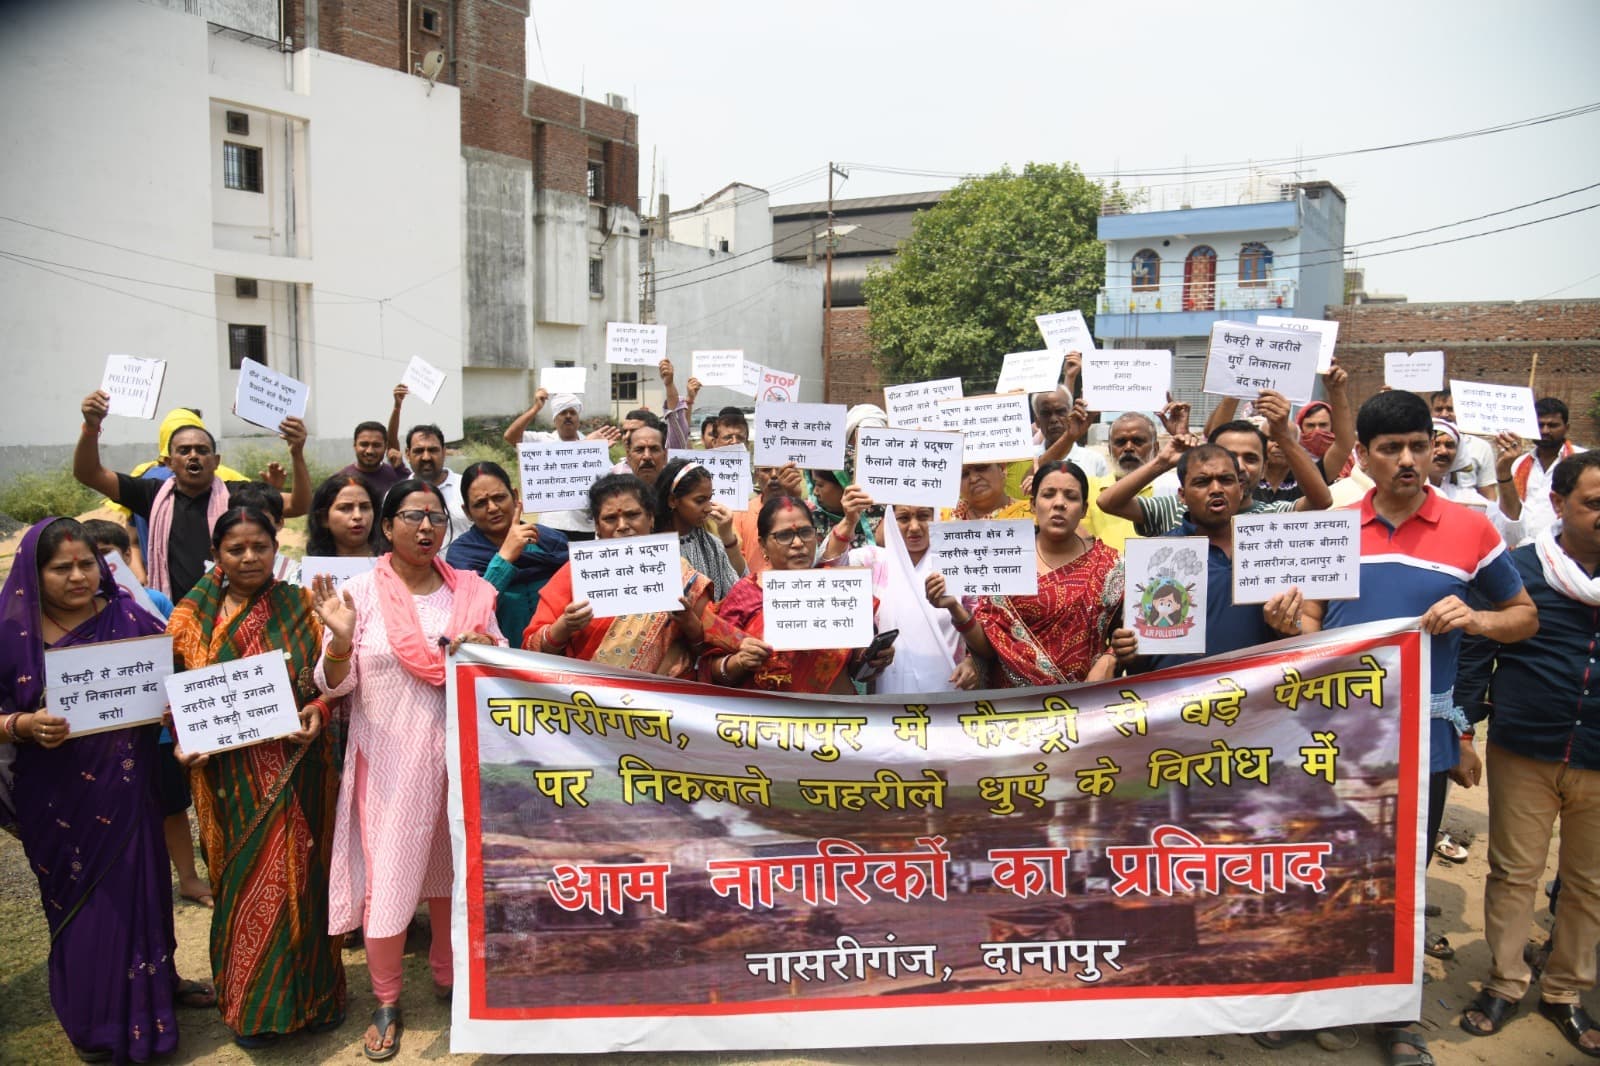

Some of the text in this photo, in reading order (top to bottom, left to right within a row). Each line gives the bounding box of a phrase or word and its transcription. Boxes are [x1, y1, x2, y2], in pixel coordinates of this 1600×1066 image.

[1224, 333, 1302, 352] फैक्ट्री से जहरीले
[1249, 356, 1291, 371] निकालना
[764, 374, 795, 386] STOP
[1236, 374, 1249, 386] बंद
[765, 419, 831, 431] फैक्ट्री से जहरीले
[780, 436, 816, 447] निकालना
[821, 437, 832, 448] बंद
[861, 436, 954, 454] ग्रीन जोन में प्रदूषण
[720, 459, 743, 468] प्रदूषण
[865, 455, 947, 471] फैलाने वाले फैक्ट्री
[719, 472, 738, 482] फैक्ट्री
[868, 475, 916, 487] चलाना बंद
[944, 528, 1015, 540] आवासीय क्षेत्र में
[1237, 524, 1264, 536] प्रदूषण
[1269, 522, 1278, 531] के
[1283, 522, 1308, 531] कारण
[1265, 539, 1283, 550] जैसी
[1289, 540, 1314, 548] घातक
[1320, 536, 1348, 547] बीमारी
[574, 544, 669, 561] ग्रीन जोन में प्रदूषण
[939, 548, 969, 559] जहरीले
[993, 546, 1022, 556] उगलने
[1242, 559, 1249, 569] से
[1337, 554, 1346, 563] के
[581, 561, 666, 580] फैलाने वाले फैक्ट्री
[942, 564, 1022, 576] वाले फैक्ट्री चलाना
[767, 578, 862, 592] ग्रीन जोन में प्रदूषण
[1240, 576, 1259, 586] लोगों
[1281, 574, 1305, 584] जीवन
[587, 584, 637, 599] चलाना बंद
[965, 583, 976, 593] बंद
[772, 597, 857, 609] फैलाने वाले फैक्ट्री
[776, 617, 826, 628] चलाना बंद
[61, 661, 154, 685] फैक्ट्री से जहरीले
[184, 666, 263, 693] आवासीय क्षेत्र में
[60, 681, 158, 710] धुएँ निकालना बंद
[182, 696, 215, 714] जहरीले
[243, 683, 275, 700] उगलने
[487, 690, 690, 750] नासरीगंज,
[716, 712, 868, 761] दानापुर
[894, 704, 931, 750] में
[1104, 689, 1149, 737] से
[1172, 676, 1246, 728] बड़े
[1275, 654, 1387, 711] पैमाने
[188, 704, 279, 732] वाले फैक्ट्री चलाना
[218, 733, 232, 745] बंद
[534, 731, 1338, 815] पर निकलते जहरीले धुएं के विरोध में
[546, 824, 1332, 915] आम नागरिकों का प्रतिवाद
[744, 932, 1126, 985] नासरीगंज, दानापुर
